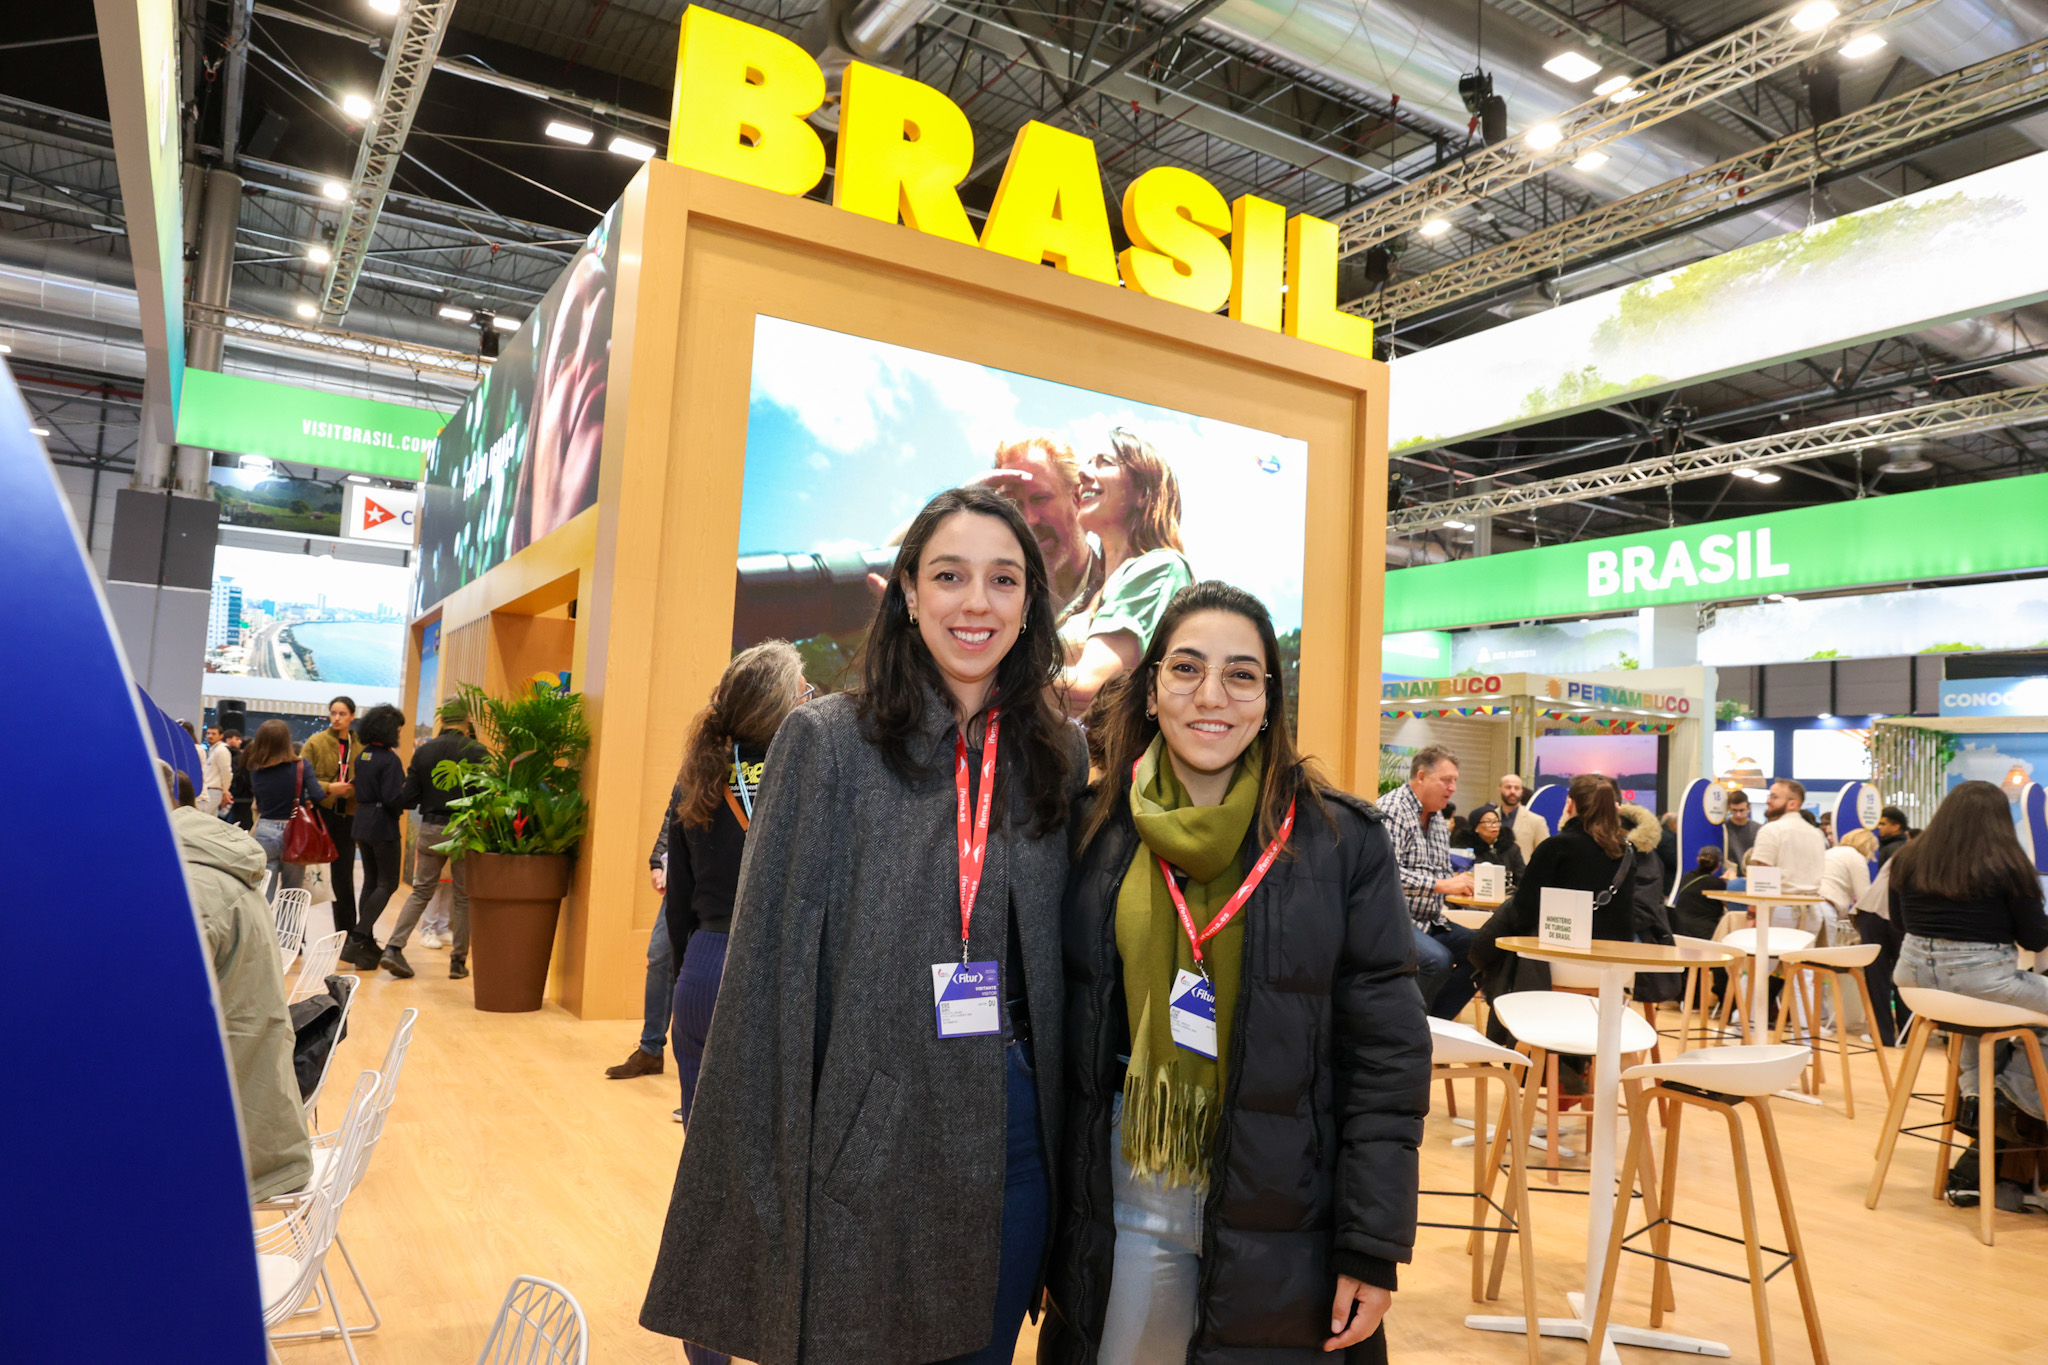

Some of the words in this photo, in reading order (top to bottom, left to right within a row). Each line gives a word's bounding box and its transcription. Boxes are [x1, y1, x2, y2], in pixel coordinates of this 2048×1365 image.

[668, 4, 1374, 359] BRASIL
[302, 419, 432, 453] VISITBRASIL.COM
[1588, 527, 1789, 597] BRASIL
[1568, 682, 1690, 713] PERNAMBUCO
[959, 787, 967, 823] ifema.es
[978, 793, 990, 829] ifema.es
[1177, 903, 1196, 940] ifema.es
[1555, 932, 1571, 941] BRASIL
